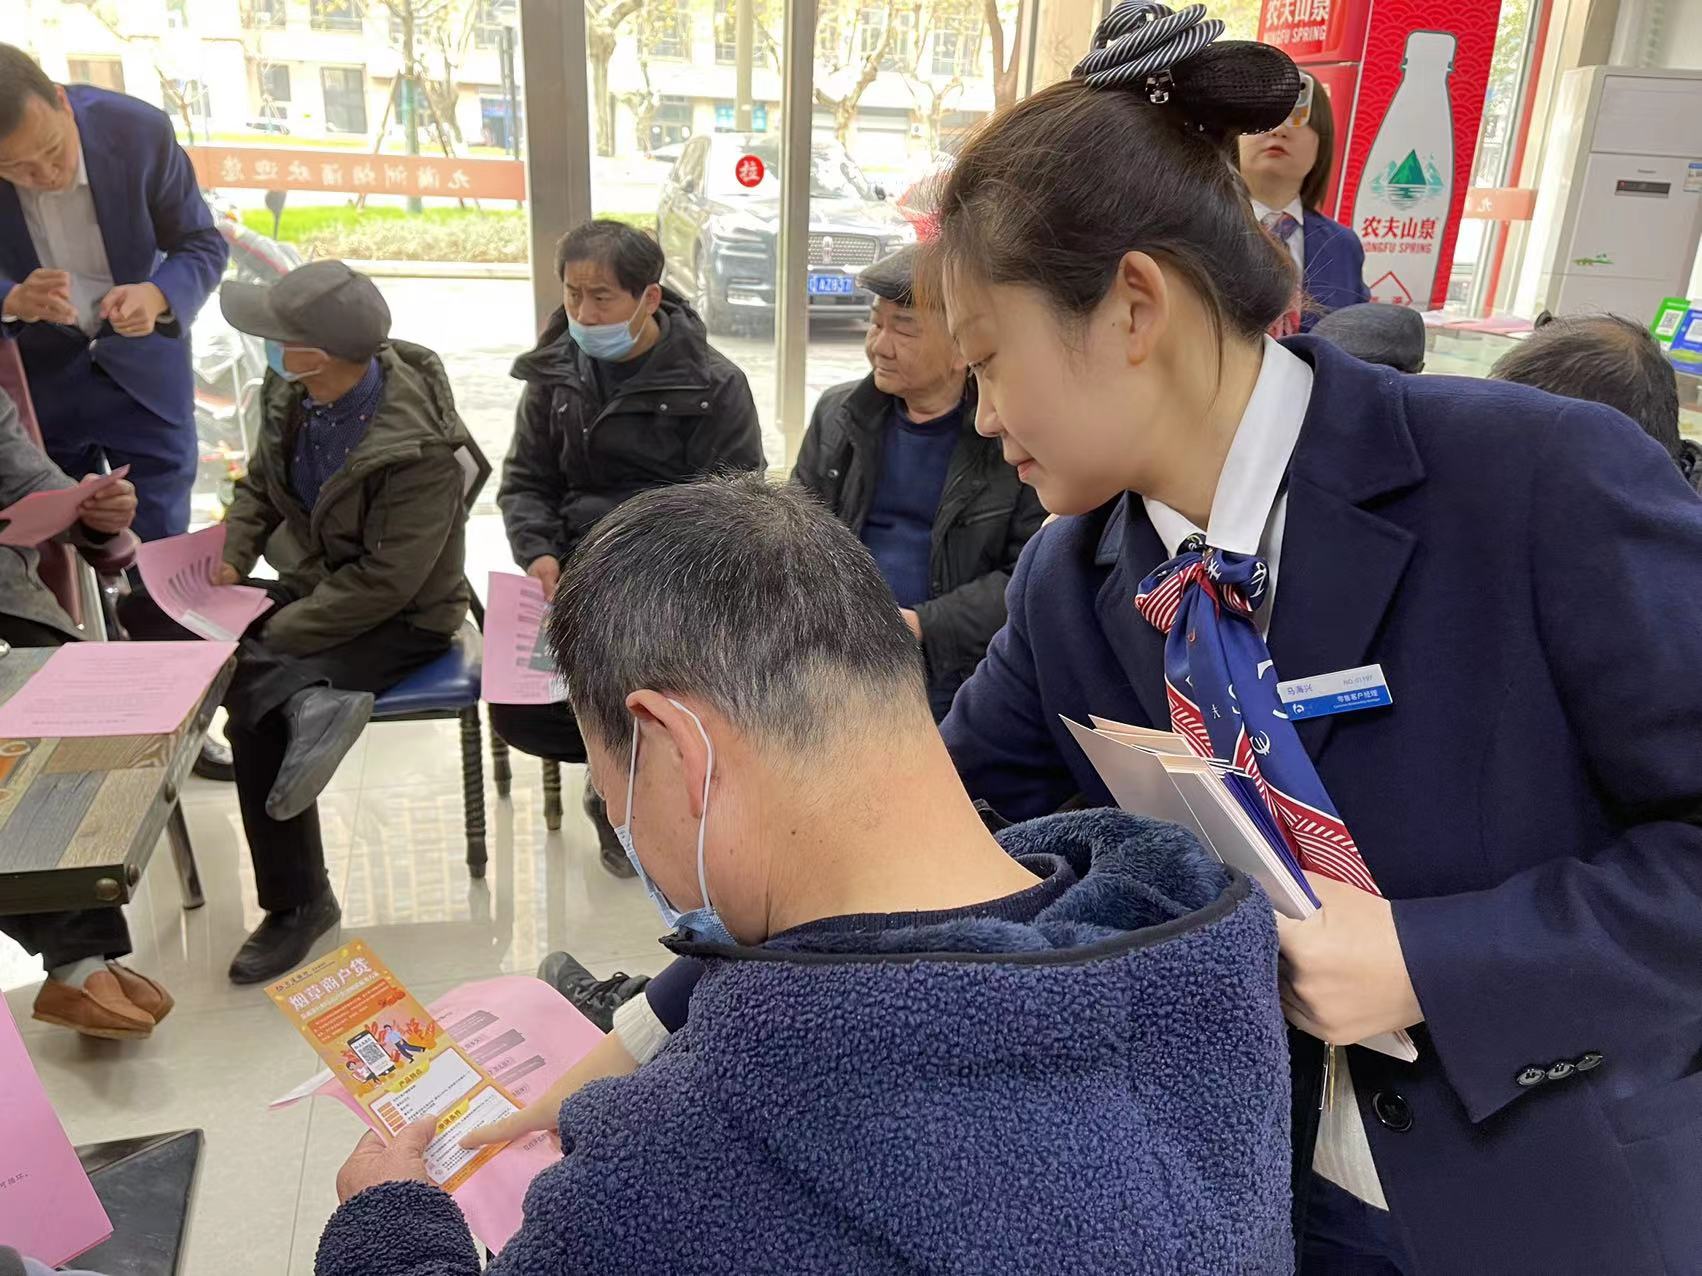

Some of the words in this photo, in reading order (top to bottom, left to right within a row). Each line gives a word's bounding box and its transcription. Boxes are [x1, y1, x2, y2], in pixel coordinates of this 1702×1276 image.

[1264, 0, 1330, 28] 农夫山泉
[1291, 26, 1327, 43] SPRING
[1362, 216, 1435, 239] 农夫山泉
[1399, 242, 1432, 254] SPRING
[287, 957, 372, 1012] 烟草商户贷
